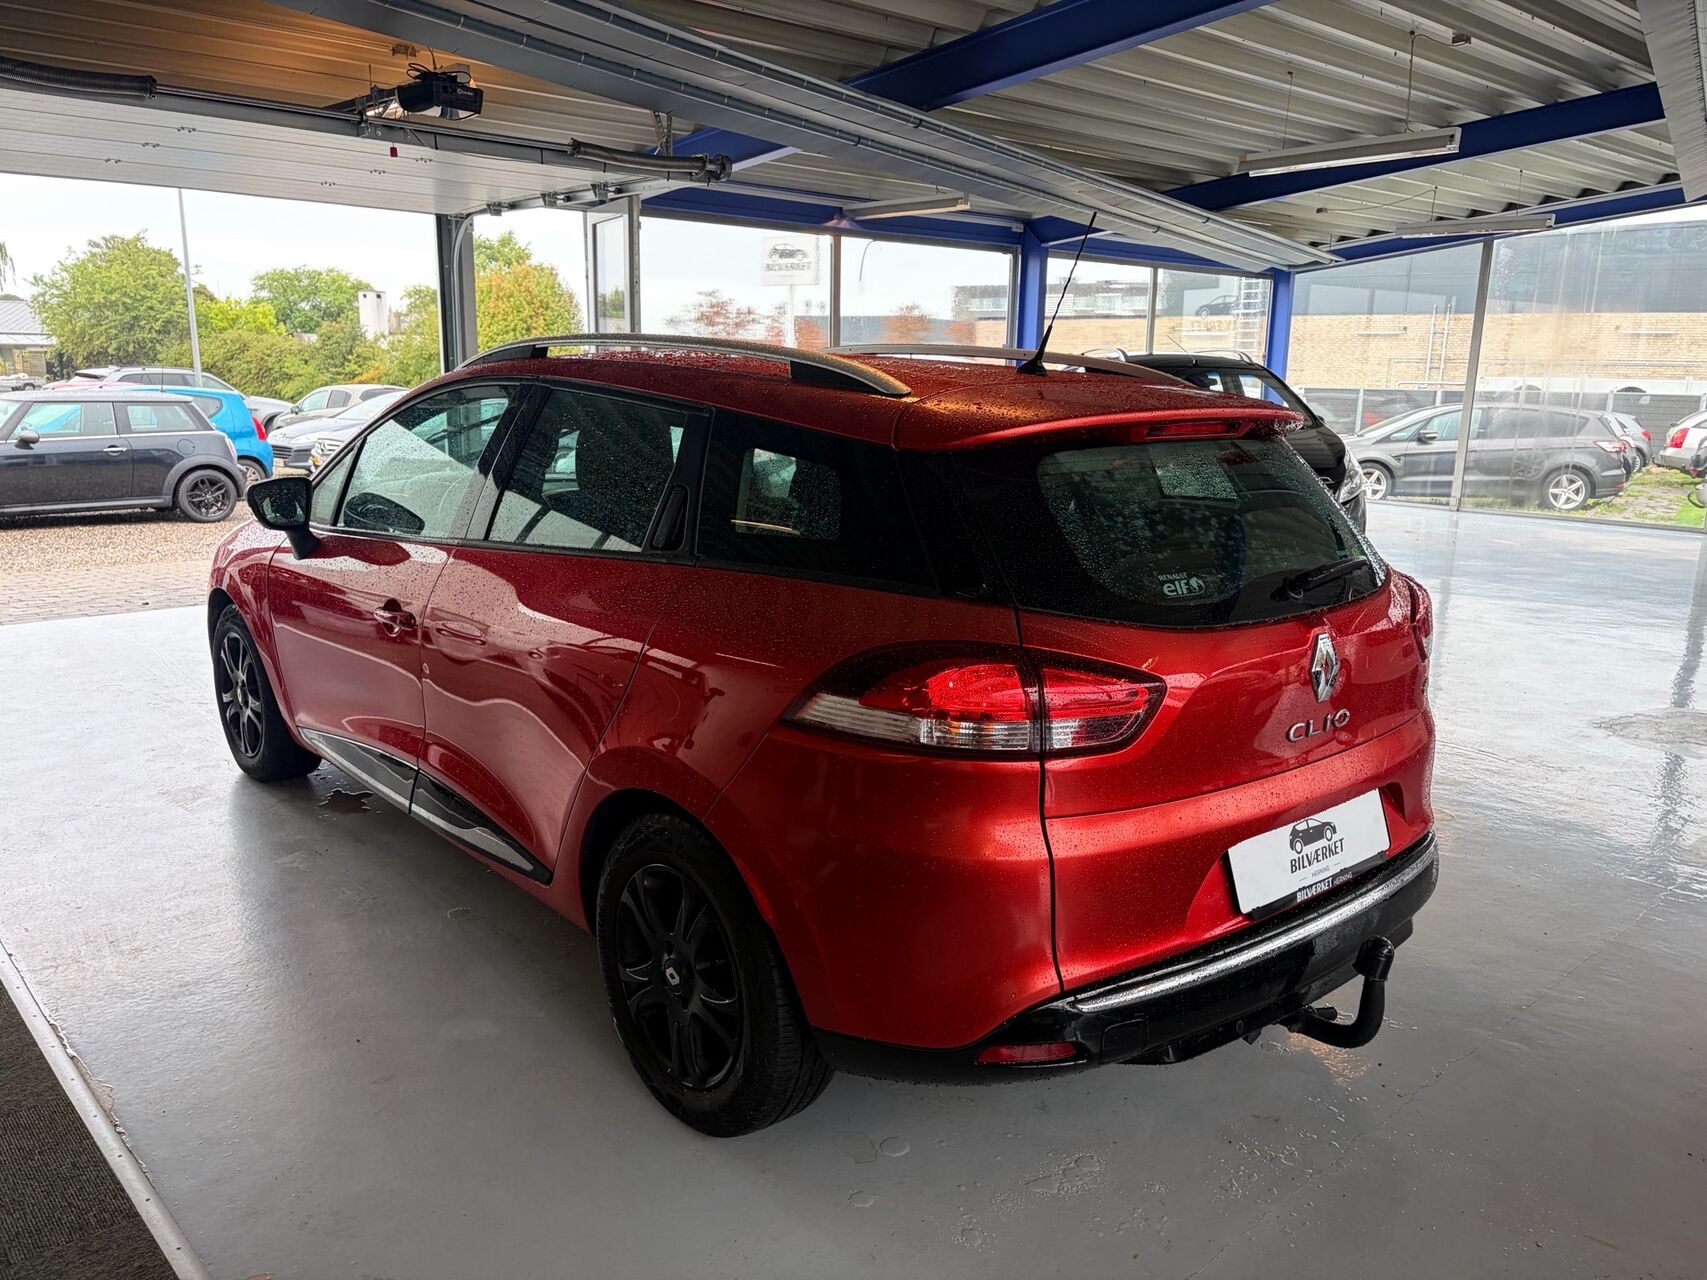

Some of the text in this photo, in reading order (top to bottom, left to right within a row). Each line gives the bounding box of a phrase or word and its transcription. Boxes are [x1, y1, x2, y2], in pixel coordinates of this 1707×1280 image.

[1163, 580, 1189, 596] elf
[1286, 708, 1350, 742] CLIO
[1290, 837, 1344, 874] BILVÆRKET
[1311, 865, 1330, 877] HERNING
[1296, 877, 1333, 902] BILVÆRKET
